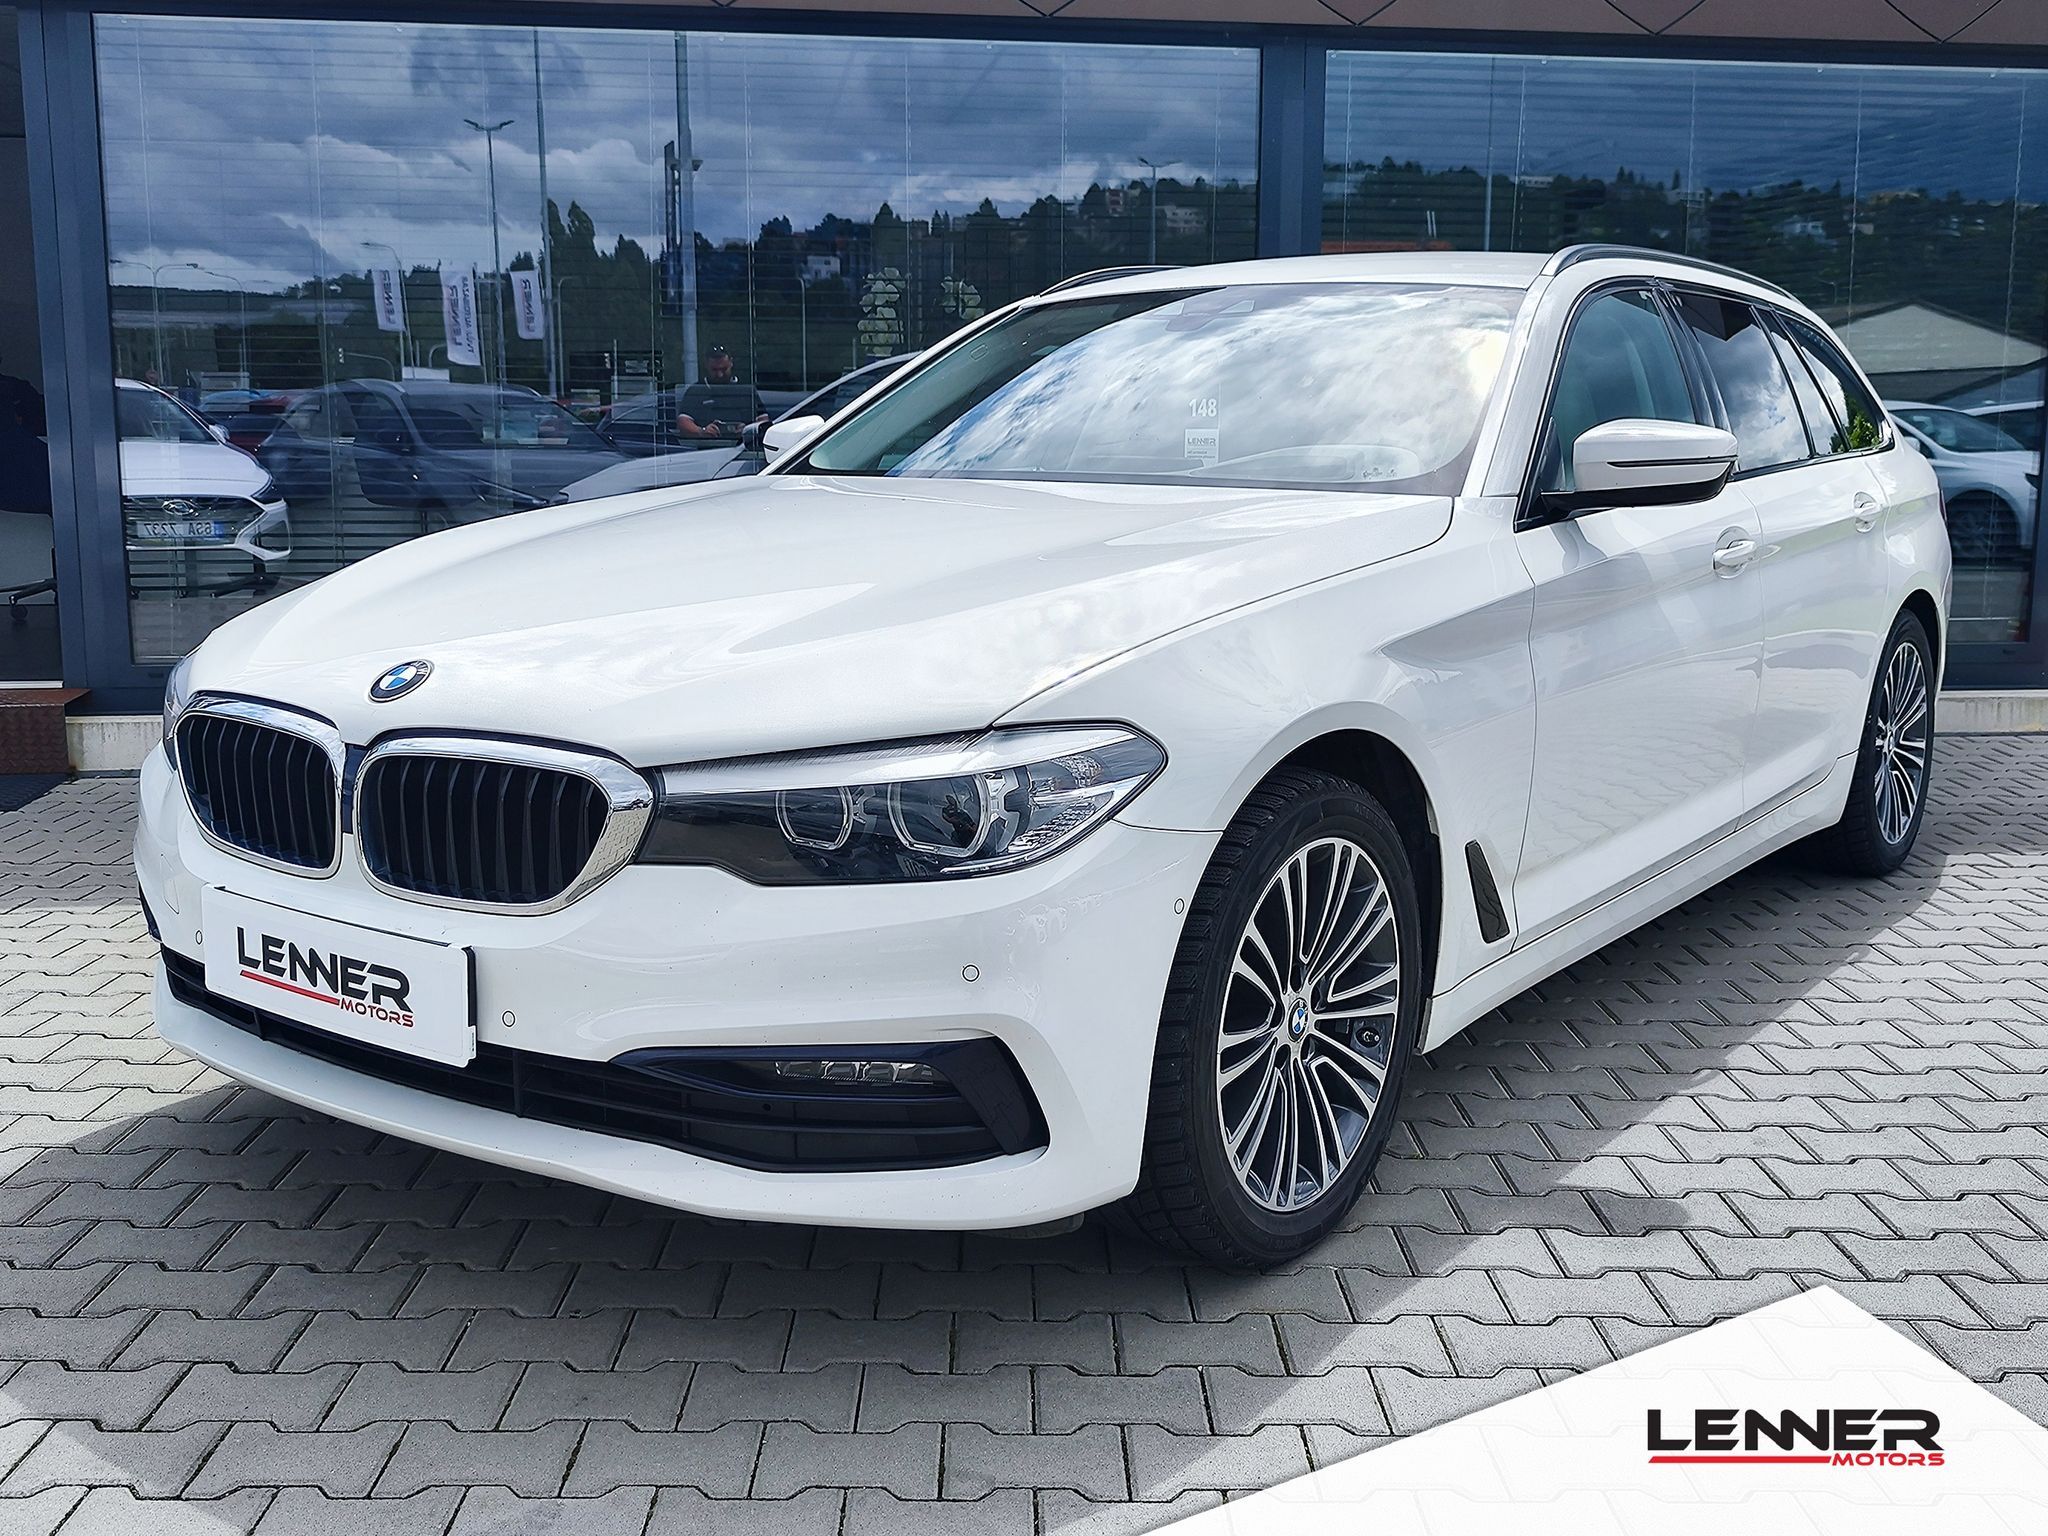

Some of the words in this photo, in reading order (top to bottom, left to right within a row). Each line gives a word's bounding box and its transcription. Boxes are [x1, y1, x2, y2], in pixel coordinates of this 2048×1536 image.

[1189, 399, 1217, 417] 148
[237, 926, 414, 1013] LENNER
[340, 998, 414, 1027] MOTORS
